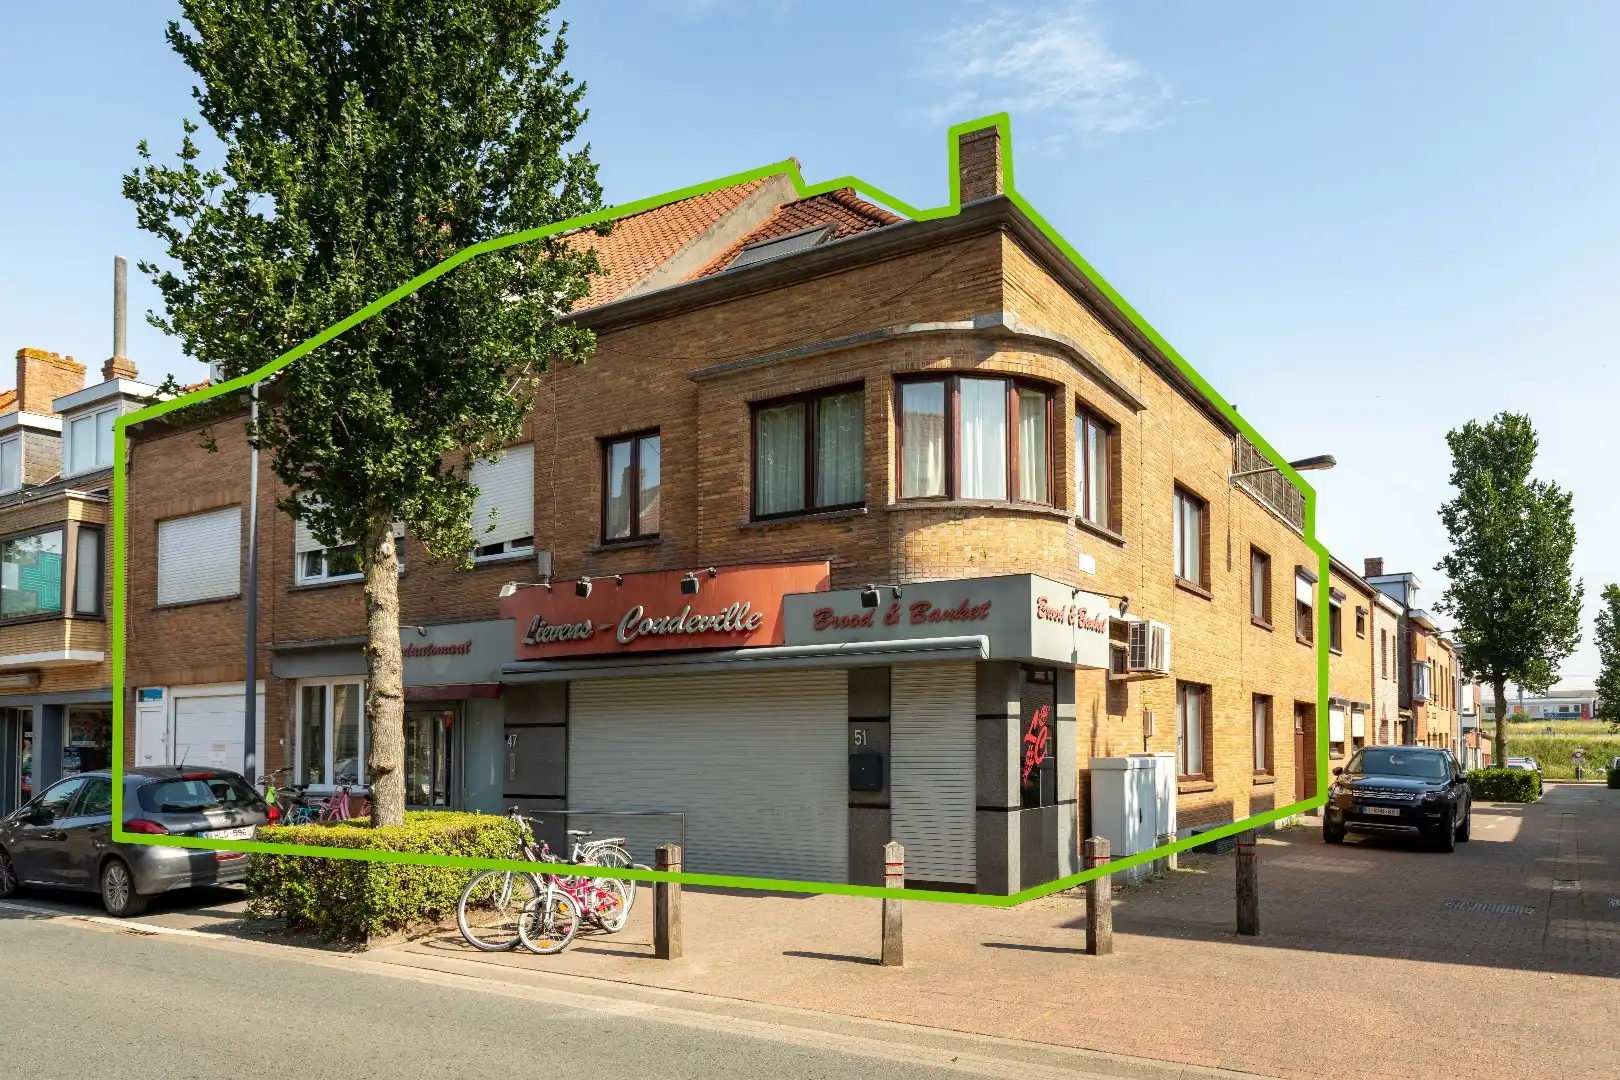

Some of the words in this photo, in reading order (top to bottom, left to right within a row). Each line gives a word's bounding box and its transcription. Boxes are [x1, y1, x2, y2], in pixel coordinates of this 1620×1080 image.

[813, 607, 876, 632] Brood
[884, 602, 901, 627] &
[1036, 596, 1066, 625] Brood
[1067, 604, 1077, 626] &
[521, 614, 594, 645] Lievens
[507, 734, 518, 748] 47
[854, 729, 867, 746] 51
